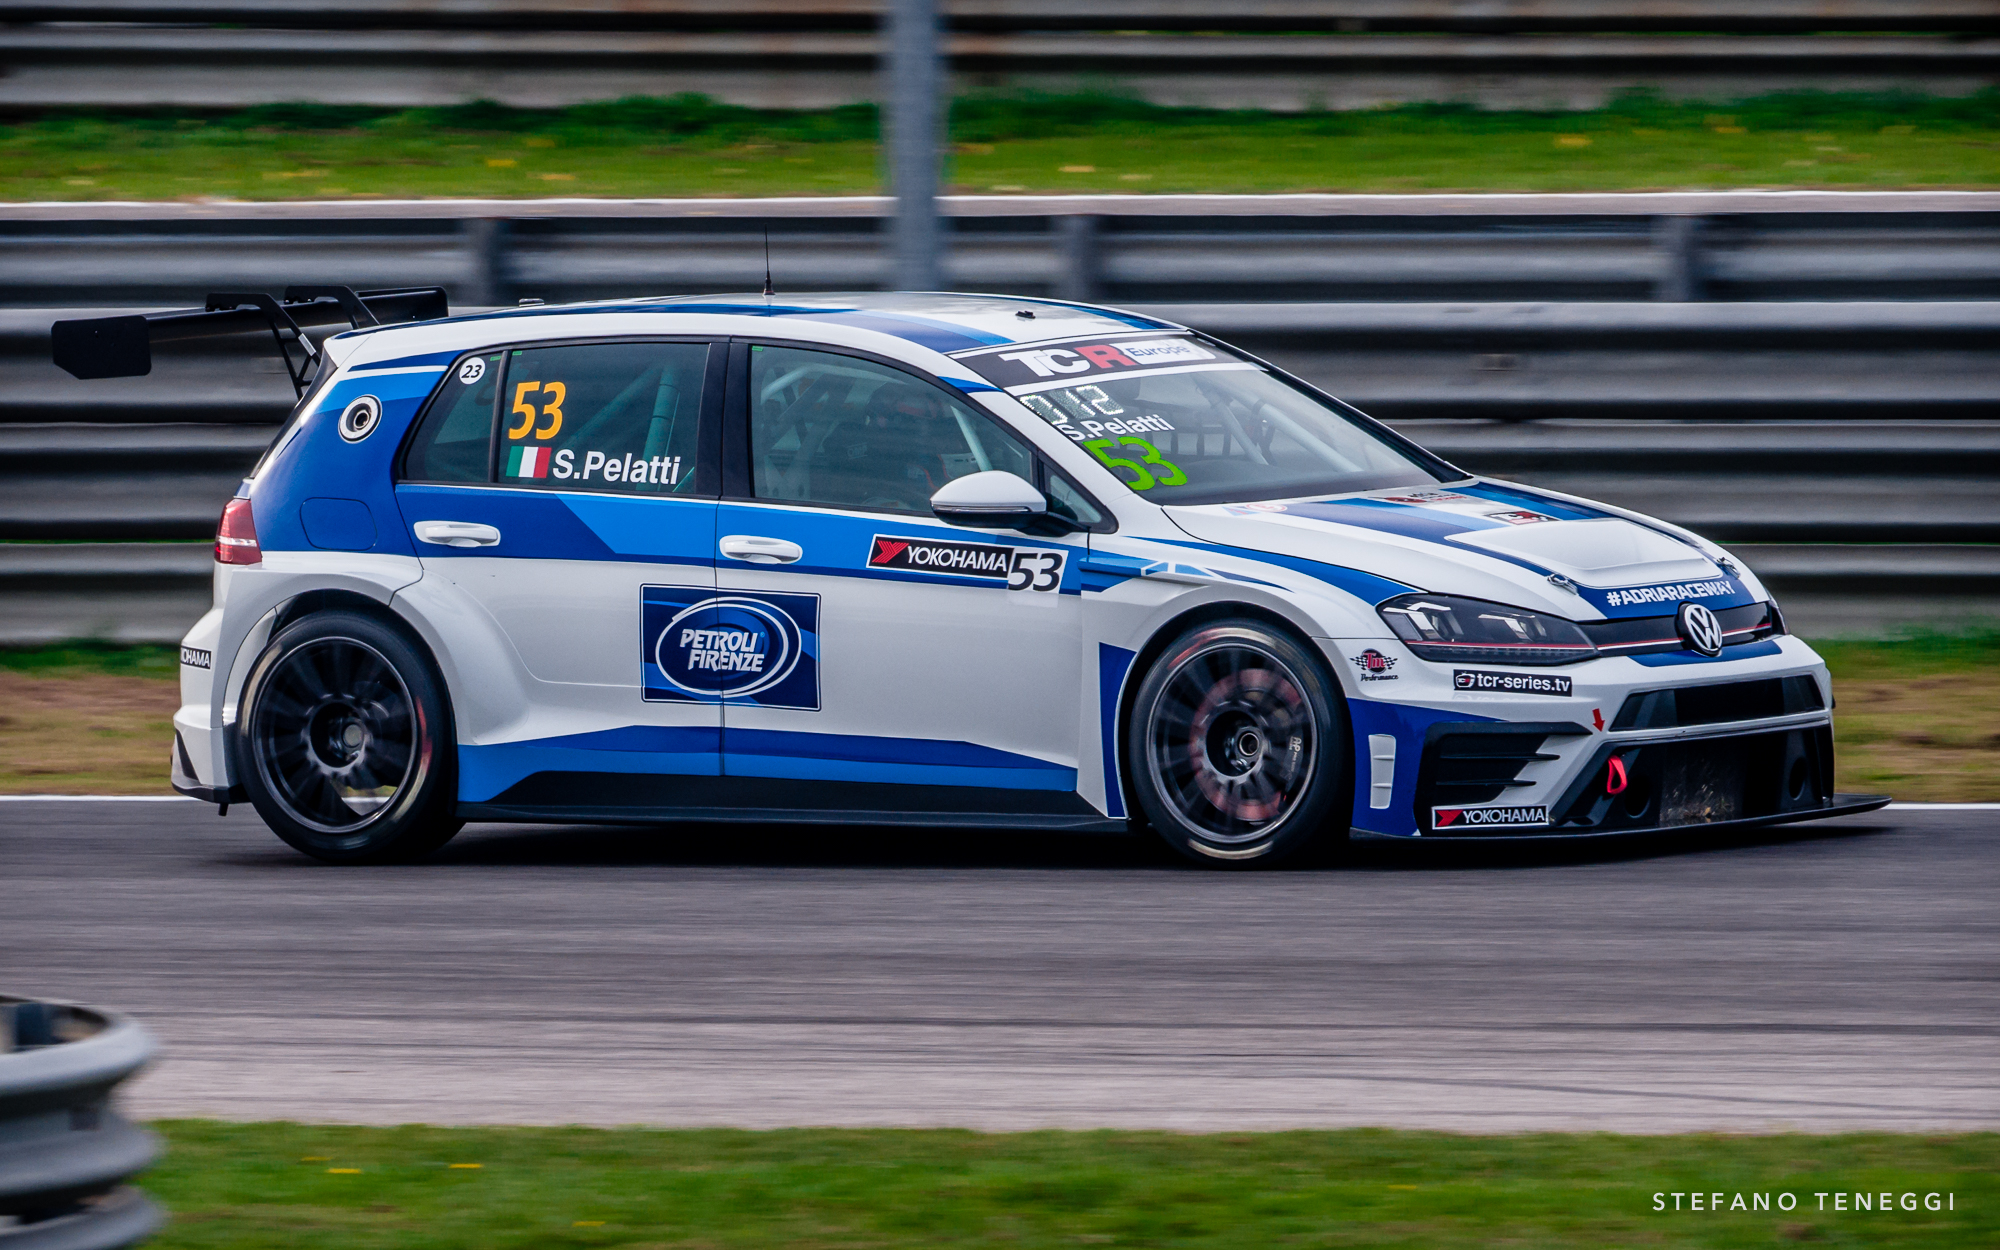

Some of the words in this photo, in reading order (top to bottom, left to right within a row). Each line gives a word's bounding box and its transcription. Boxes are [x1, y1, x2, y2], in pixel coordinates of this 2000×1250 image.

[461, 364, 483, 379] 23
[997, 344, 1138, 377] TCR
[1124, 345, 1191, 357] Europe
[508, 381, 567, 440] 53
[1056, 413, 1176, 442] S.Pelatti
[552, 448, 681, 485] S.Pelatti
[1082, 436, 1189, 491] 53
[907, 545, 1008, 572] YOKOHAMA
[1008, 552, 1064, 592] 53
[1606, 580, 1736, 607] #ADRIARACEWAY
[679, 628, 759, 653] PETROLI
[181, 648, 211, 668] OHAMA
[687, 649, 765, 672] FIRENZE
[1476, 673, 1571, 692] tcr-series.tv
[1462, 808, 1545, 824] YOKOHAMA
